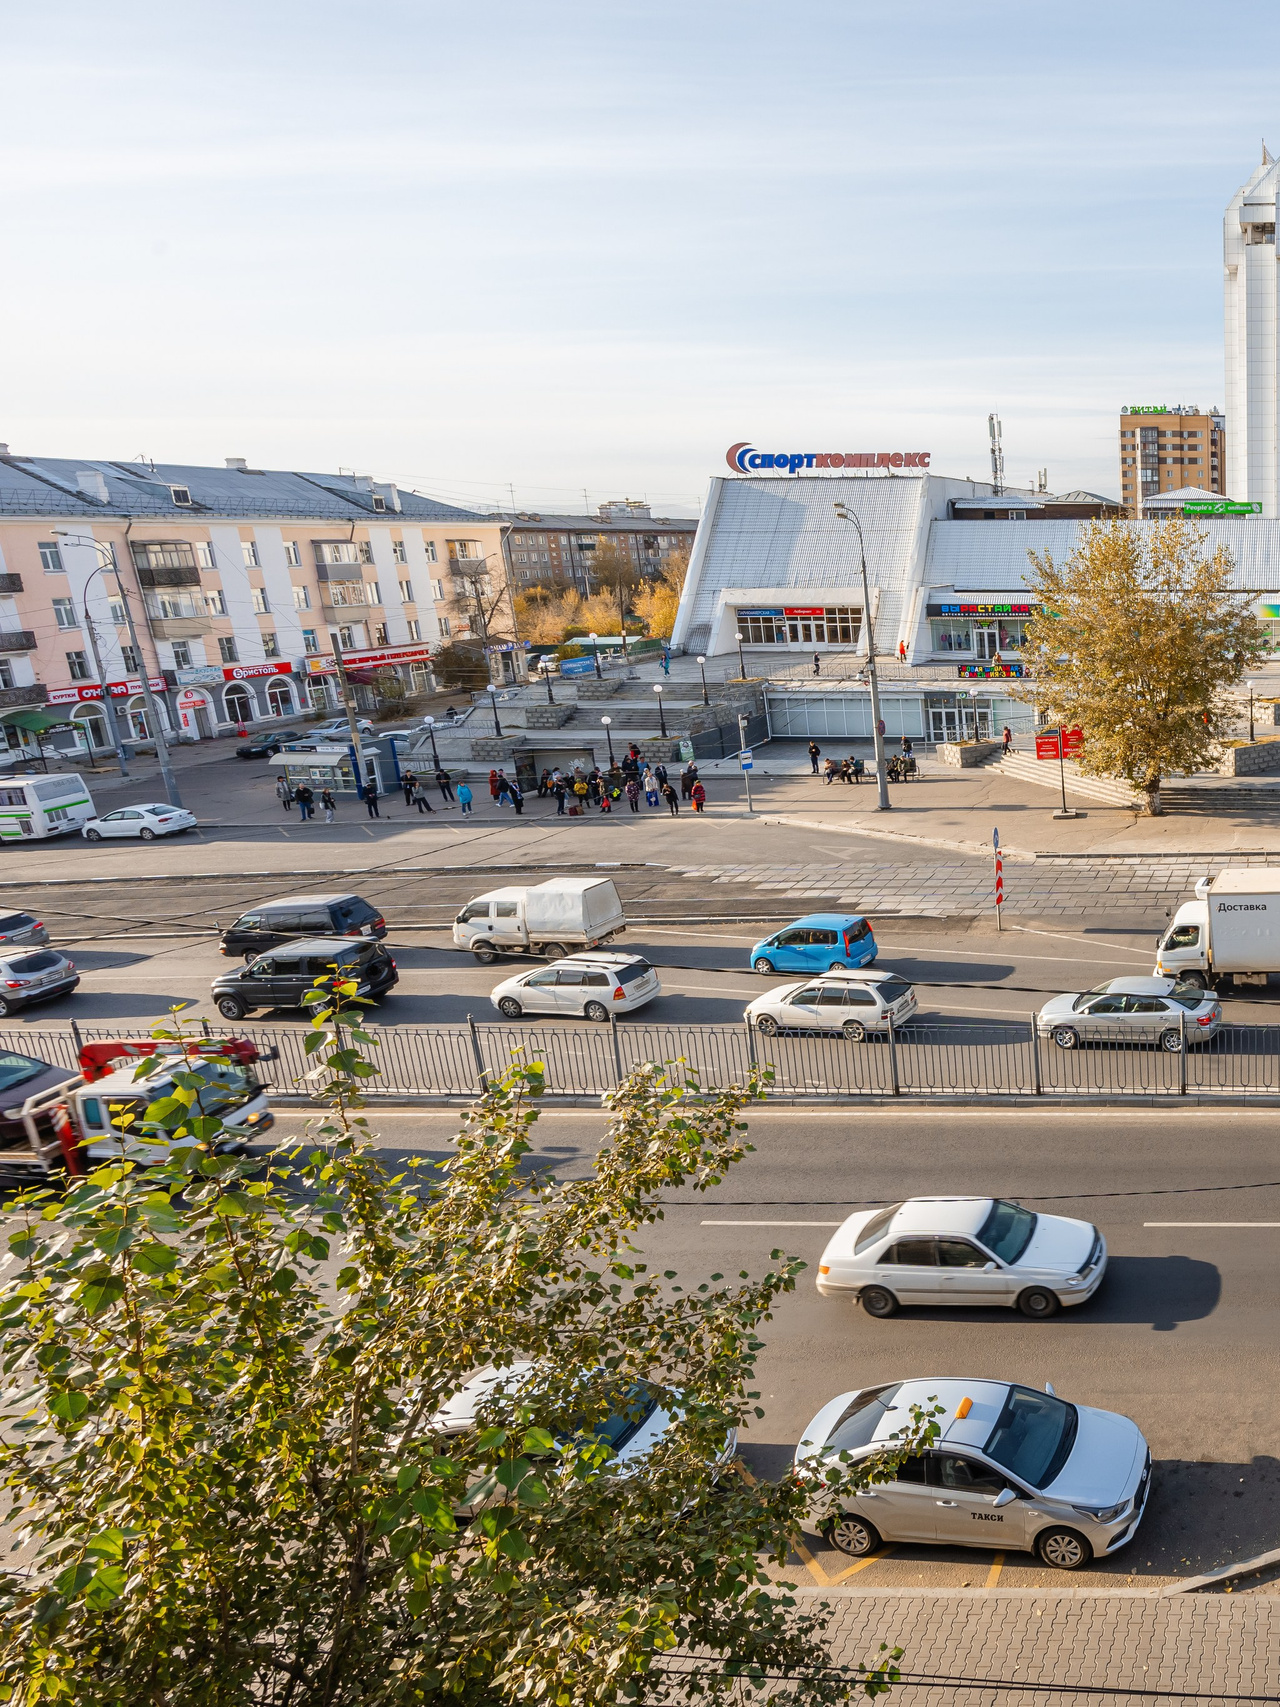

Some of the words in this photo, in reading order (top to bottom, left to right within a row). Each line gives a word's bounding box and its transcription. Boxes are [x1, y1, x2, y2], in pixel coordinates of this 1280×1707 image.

[941, 604, 1029, 612] ВЫРАСТАЙКА
[52, 692, 76, 700] КУРТКИ
[1218, 902, 1267, 912] Доставка
[970, 1512, 1004, 1522] ТАКСИ
